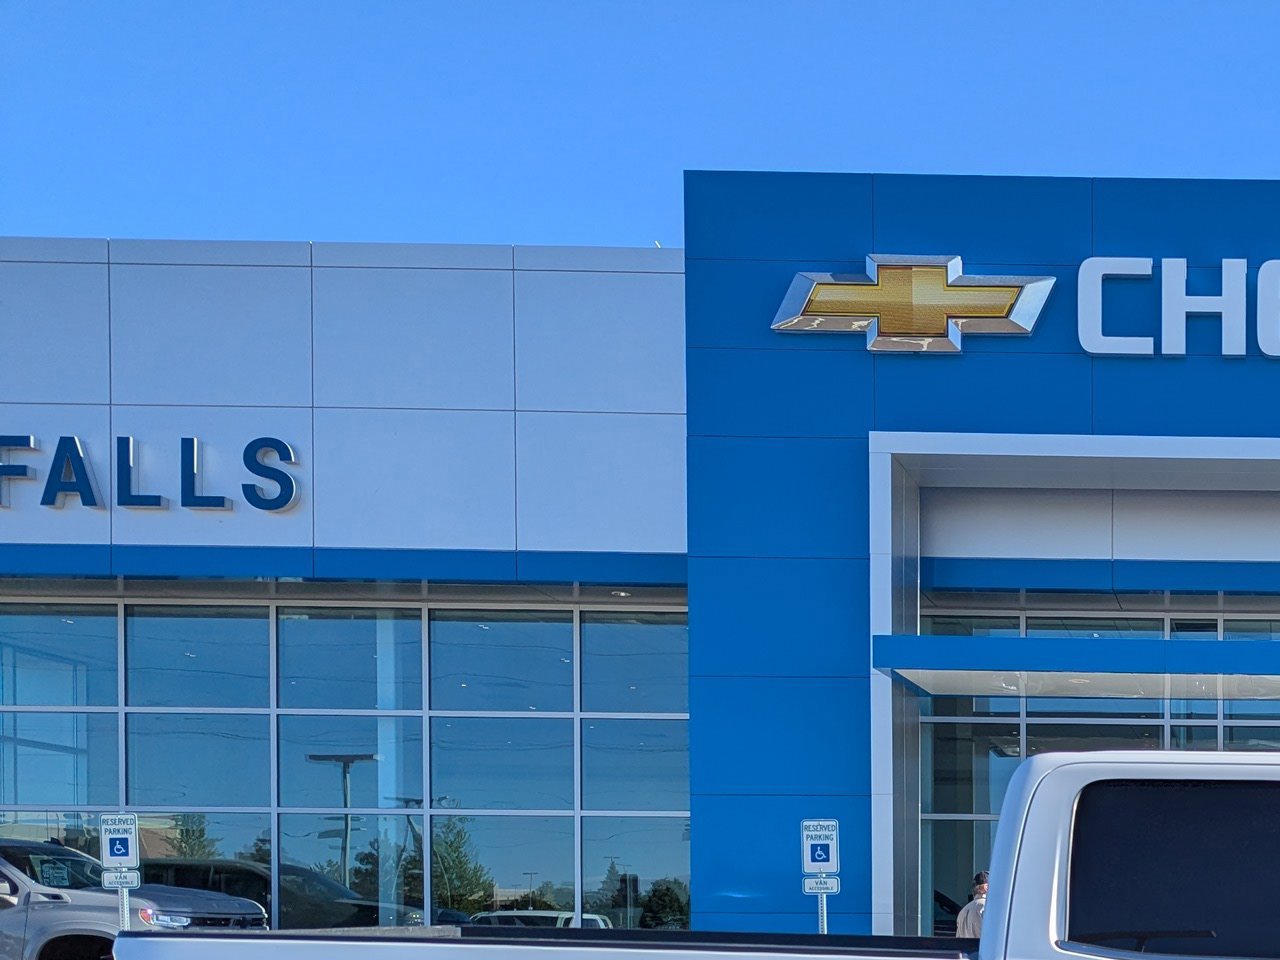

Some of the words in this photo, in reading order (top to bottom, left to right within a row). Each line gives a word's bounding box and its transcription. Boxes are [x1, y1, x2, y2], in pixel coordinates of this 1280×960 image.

[0, 435, 301, 512] FALLS
[102, 818, 135, 826] RESERVED
[804, 824, 836, 832] RESERVED
